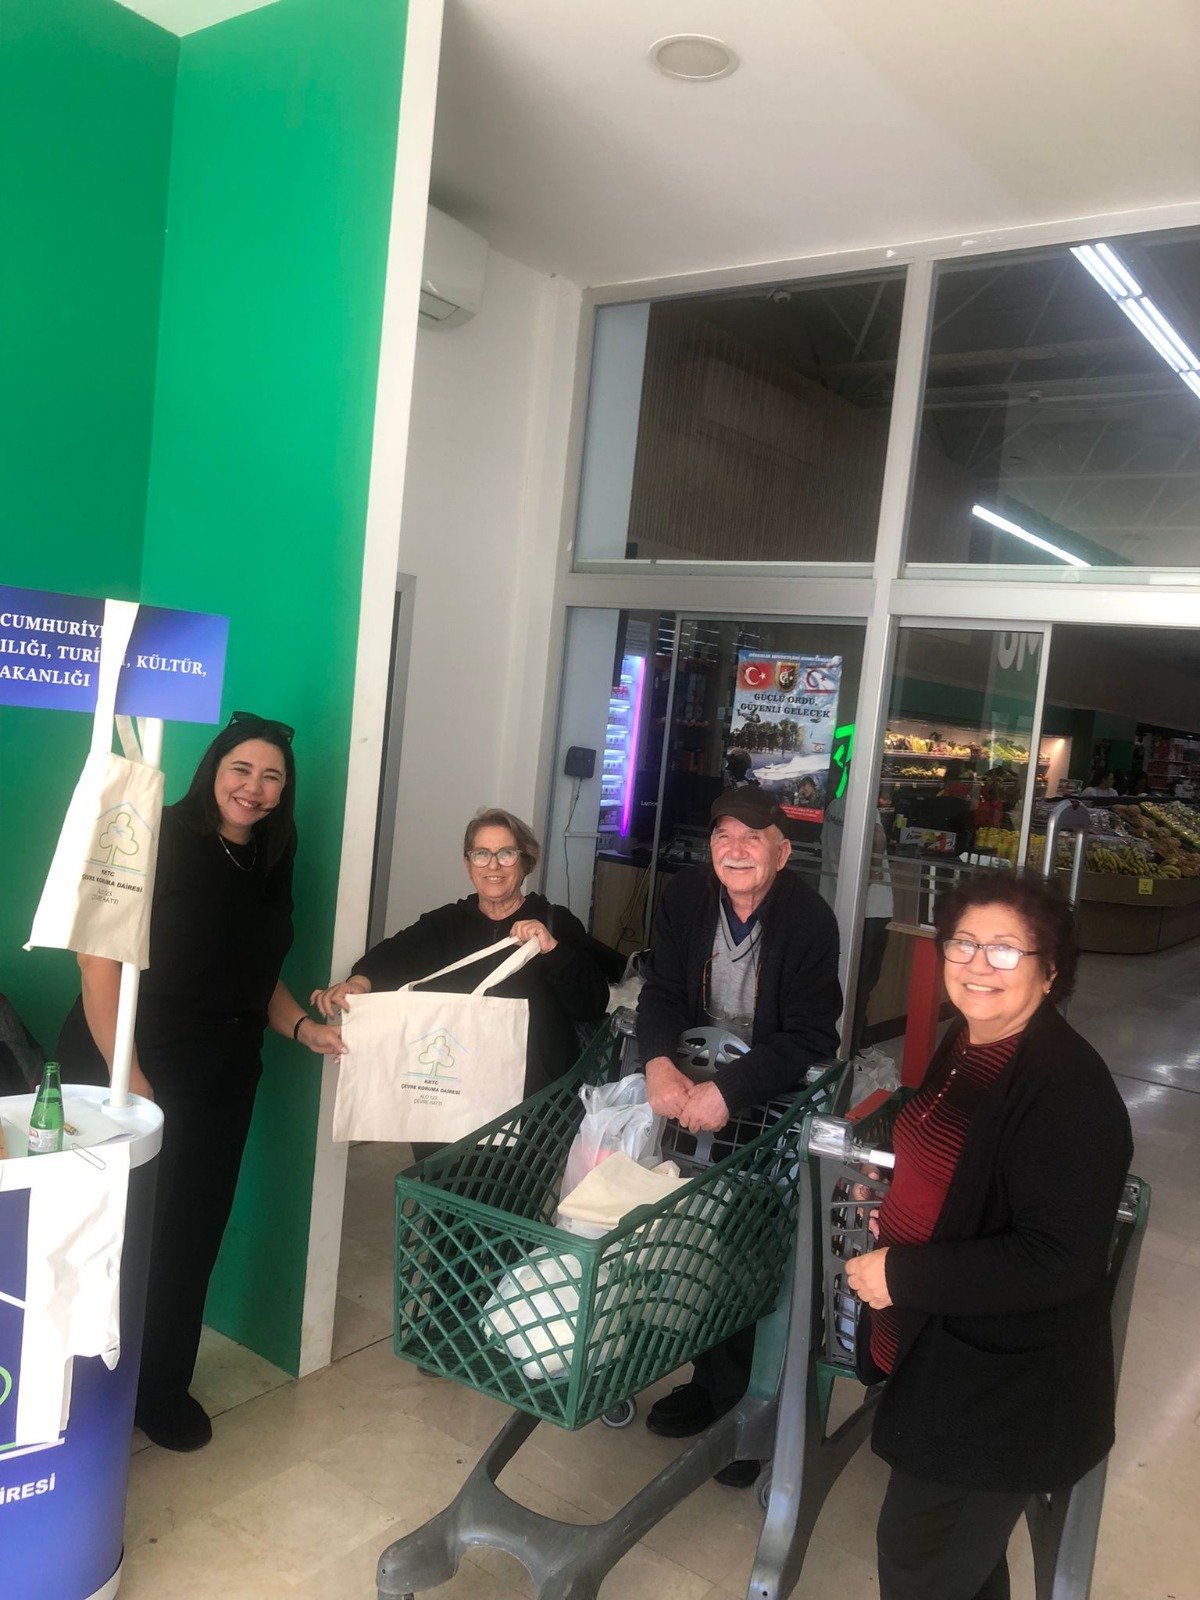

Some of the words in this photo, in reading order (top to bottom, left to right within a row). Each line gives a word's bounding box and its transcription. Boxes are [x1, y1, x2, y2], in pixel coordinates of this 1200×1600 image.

[0, 613, 103, 638] CUMHURİY
[57, 645, 131, 669] TURİ,
[136, 653, 207, 678] KÜLTÜR,
[0, 664, 91, 687] AKANLIĞI
[784, 706, 831, 718] GELECEK
